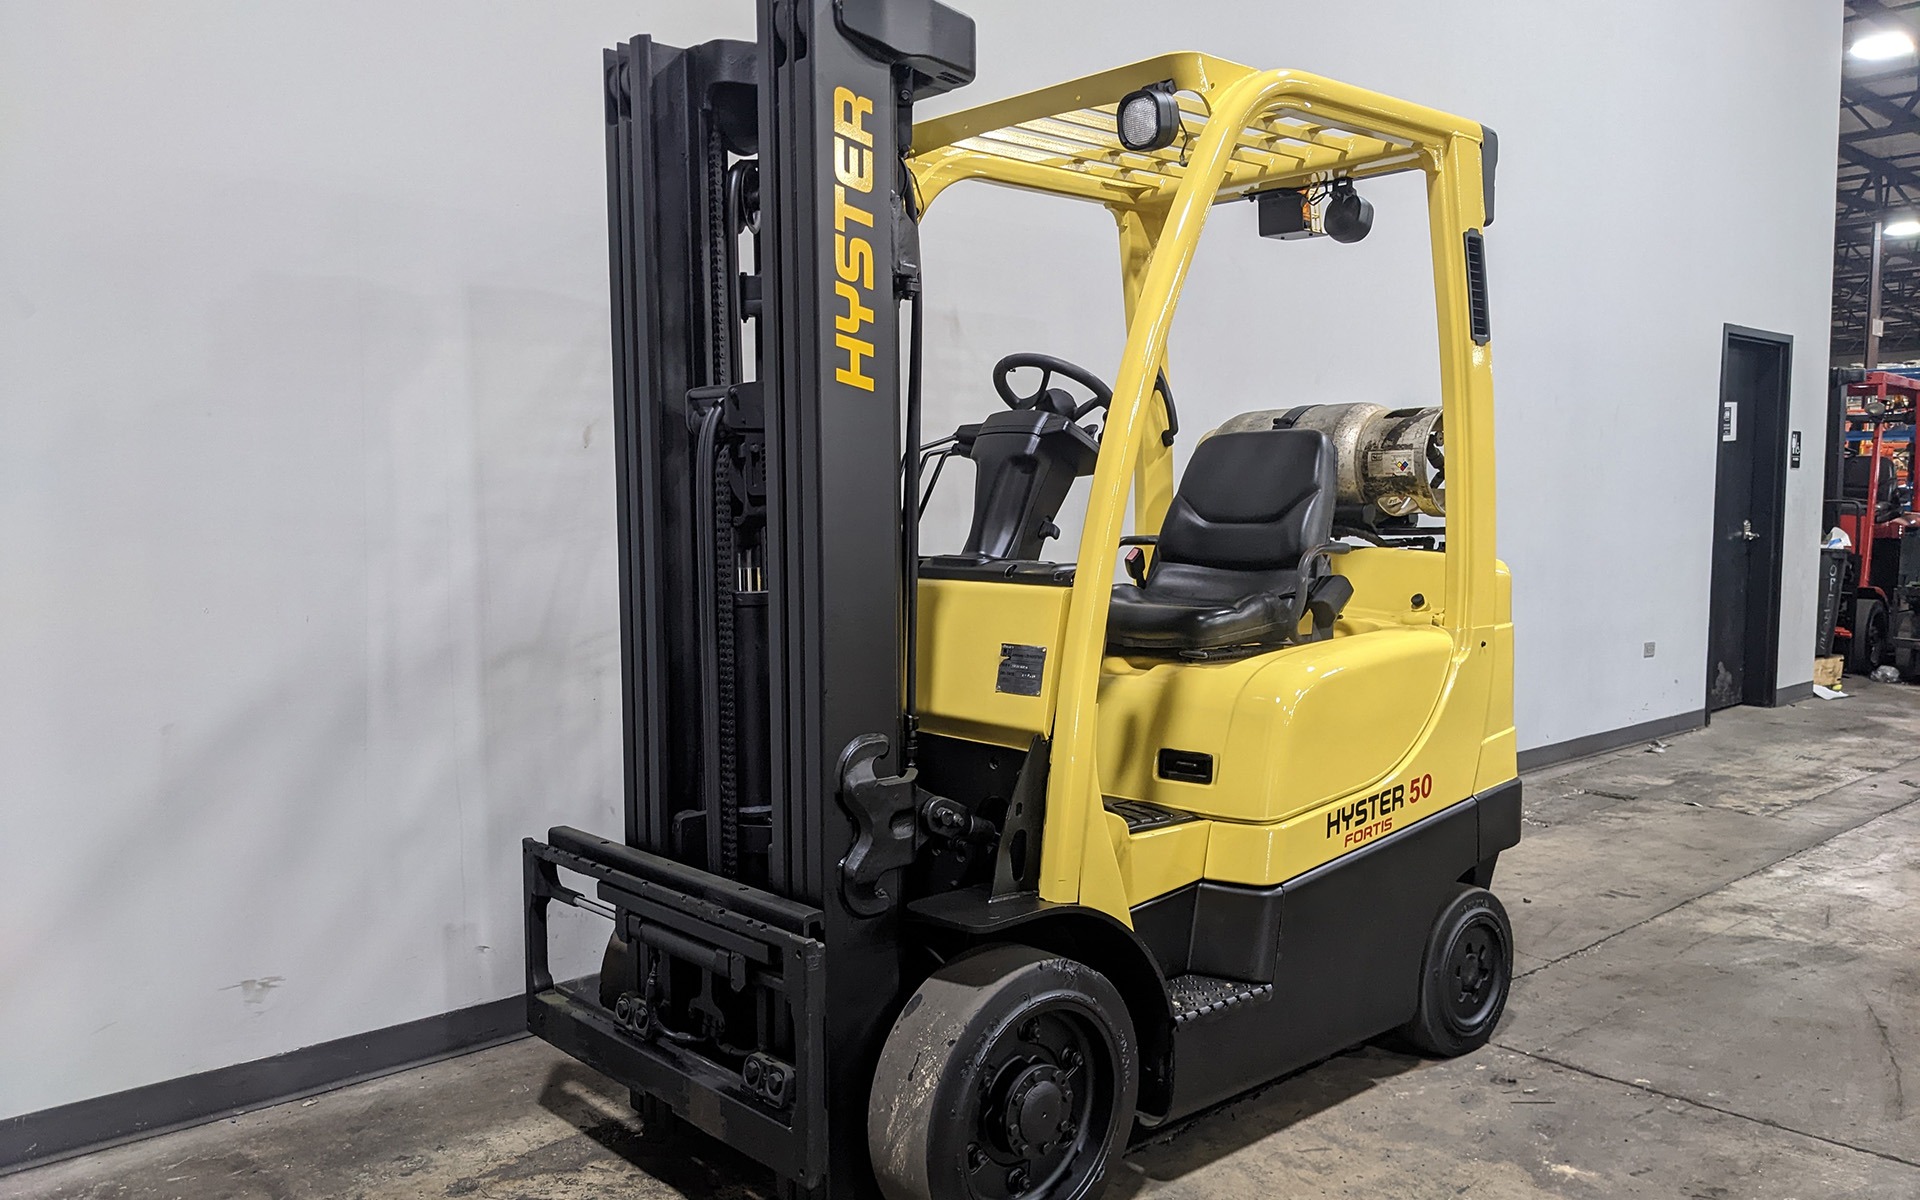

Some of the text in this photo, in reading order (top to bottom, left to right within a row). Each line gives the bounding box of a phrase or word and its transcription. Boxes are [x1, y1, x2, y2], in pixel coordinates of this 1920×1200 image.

[834, 86, 875, 392] HYSTER
[1326, 773, 1432, 839] HYSTER 50
[1344, 817, 1393, 848] FORTIS
